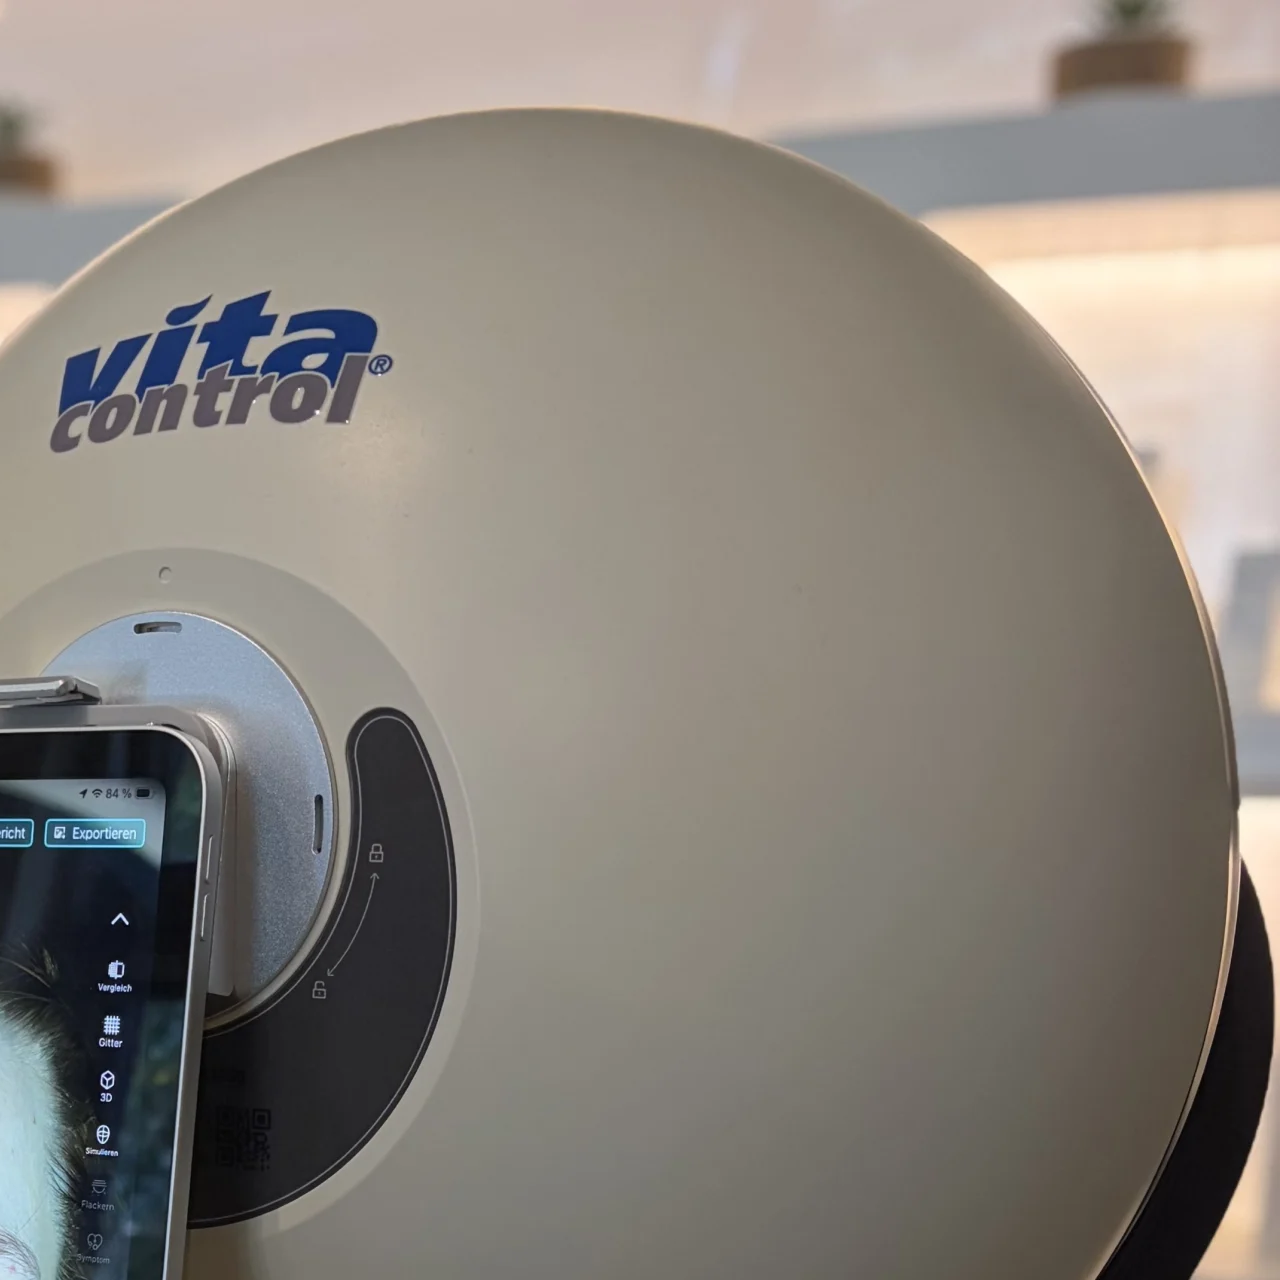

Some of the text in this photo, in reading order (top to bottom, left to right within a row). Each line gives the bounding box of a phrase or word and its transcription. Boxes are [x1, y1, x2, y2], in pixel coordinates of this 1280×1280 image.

[59, 290, 378, 416] vita
[106, 788, 132, 799] 84 %
[72, 826, 137, 843] Exportieren
[97, 983, 133, 994] Vergleich
[98, 1037, 123, 1048] Gitter
[100, 1092, 113, 1103] 3D
[85, 1147, 119, 1158] Simulieren
[81, 1199, 115, 1212] Flackern
[76, 1253, 111, 1265] Symptom
